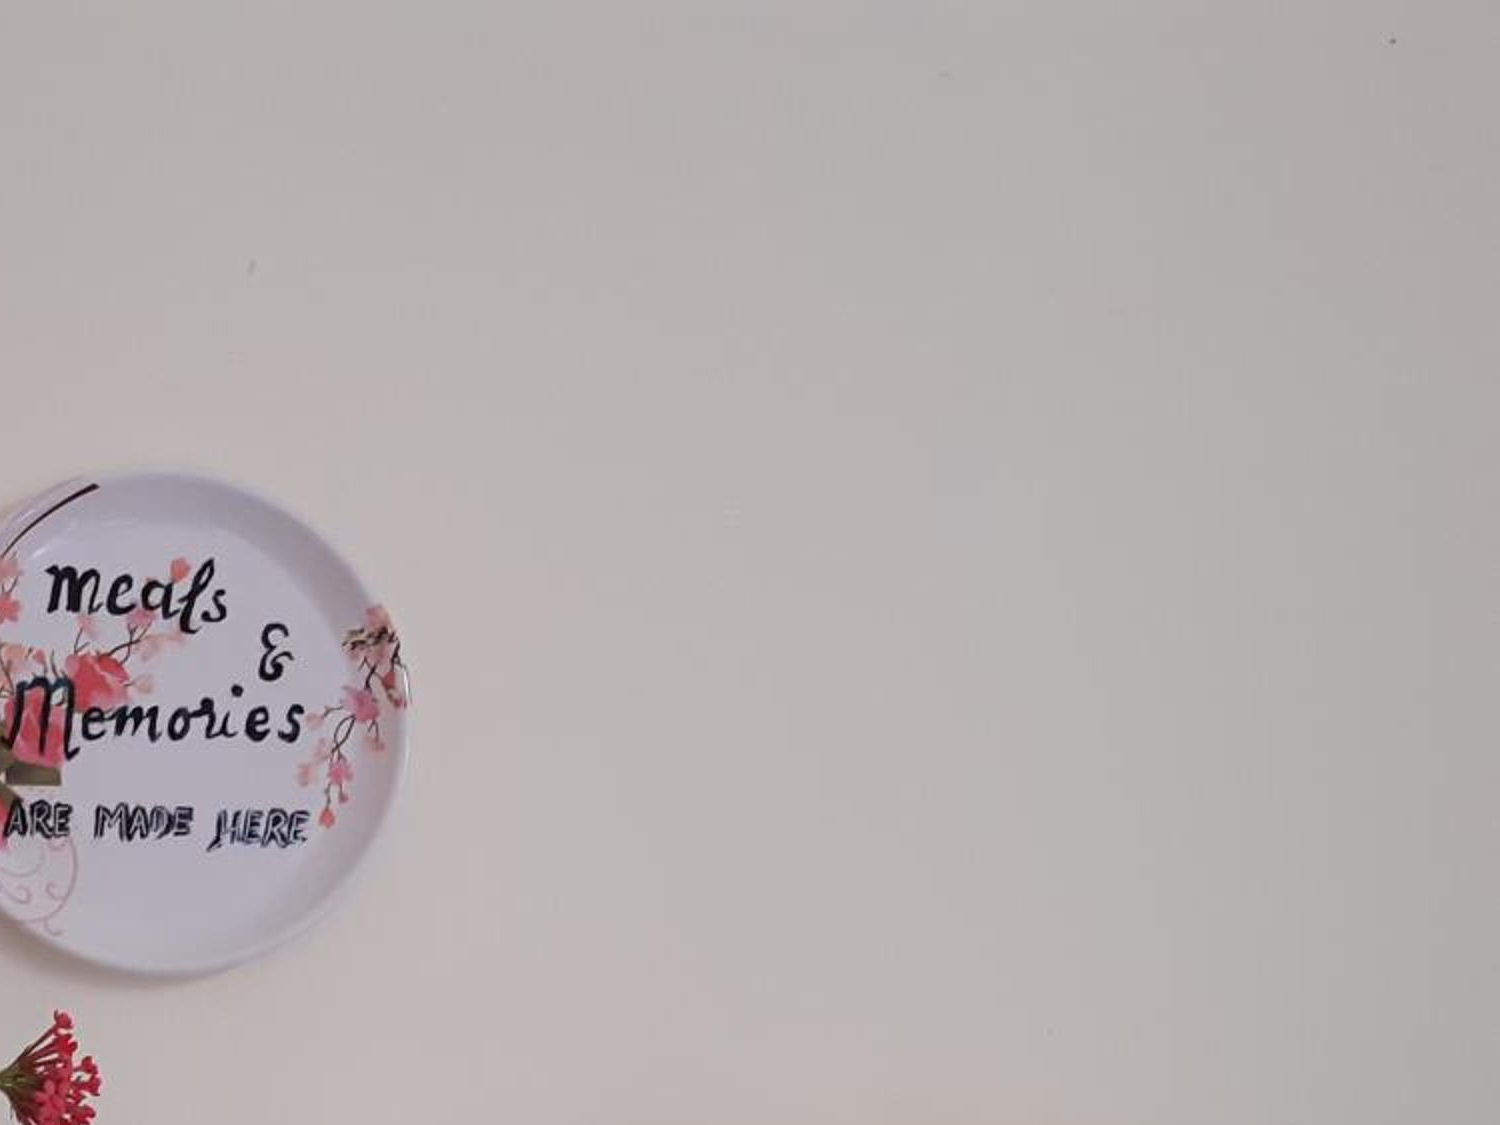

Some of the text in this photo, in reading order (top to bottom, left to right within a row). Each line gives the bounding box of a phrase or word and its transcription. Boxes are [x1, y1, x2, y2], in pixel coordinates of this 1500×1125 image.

[257, 622, 294, 682] &
[3, 800, 312, 852] ARE MADE HERE
